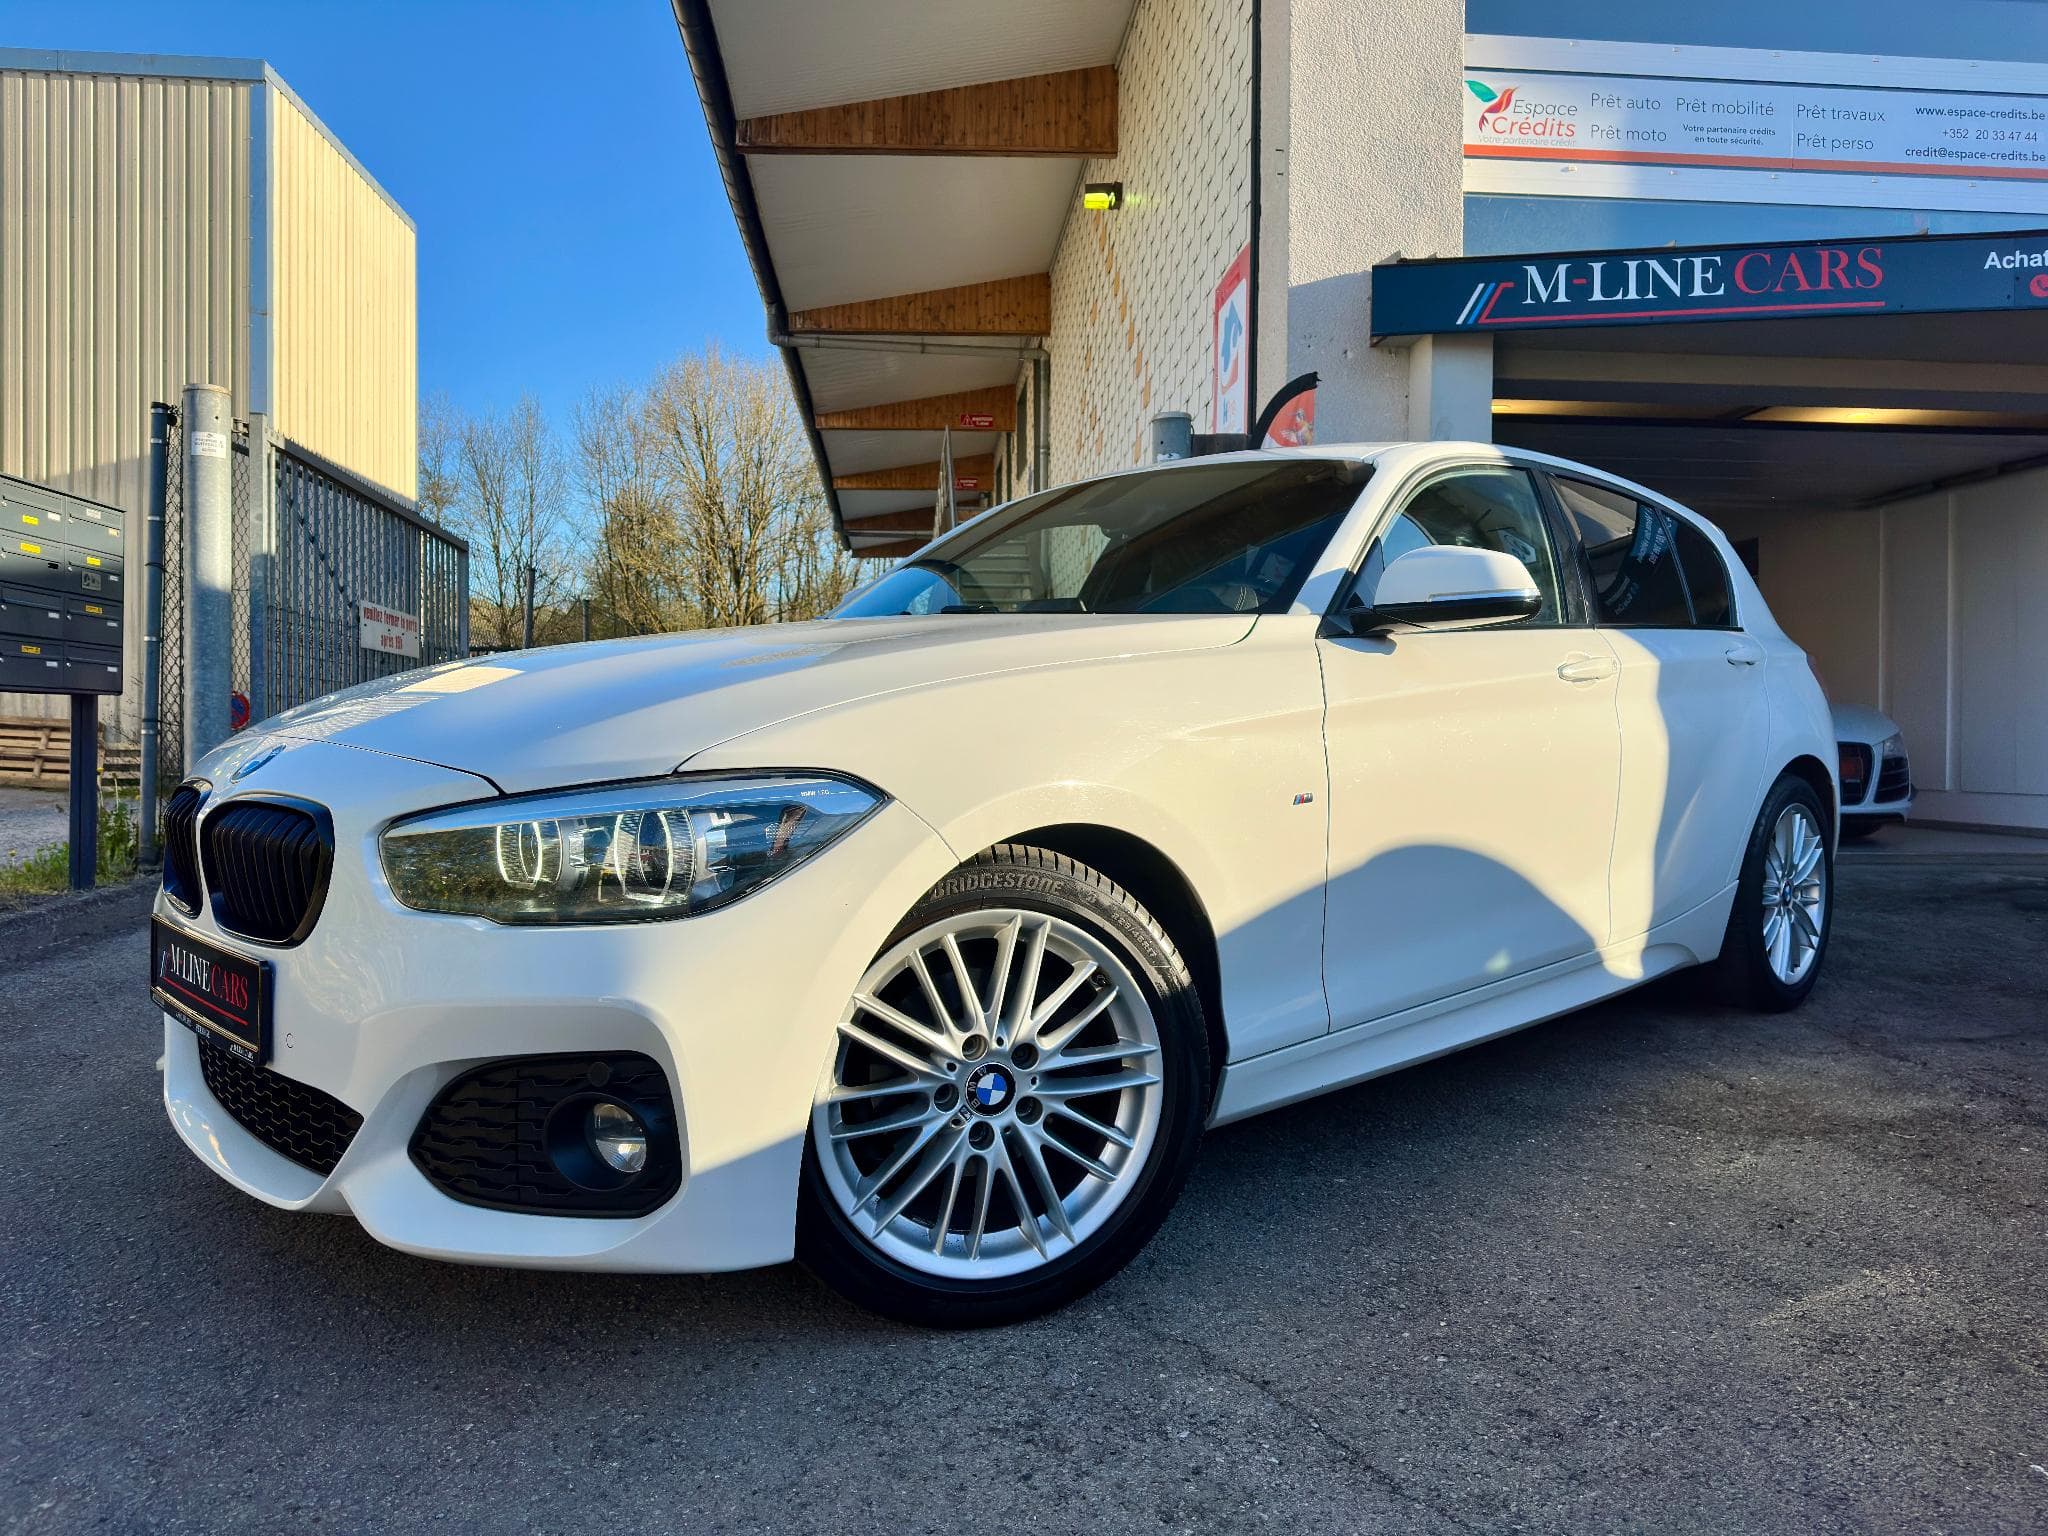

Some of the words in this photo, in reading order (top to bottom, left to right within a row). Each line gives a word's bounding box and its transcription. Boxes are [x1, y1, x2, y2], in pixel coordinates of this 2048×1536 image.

[1513, 99, 1578, 117] Espace
[1591, 92, 1621, 109] Prêt
[1626, 97, 1661, 111] auto
[1676, 97, 1706, 114] Prêt
[1711, 99, 1774, 116] mobilité
[1797, 103, 1826, 120] Prêt
[1831, 107, 1886, 123] travaux
[1915, 105, 2046, 121] www.espace-credits.be
[1493, 116, 1577, 137] Crédits
[1590, 124, 1621, 141] Prêt
[1626, 128, 1667, 142] moto
[1682, 123, 1705, 133] Votre
[1706, 125, 1748, 136] partenaire
[1749, 126, 1776, 136] crédits
[1942, 128, 1969, 140] +352
[1975, 129, 1989, 140] 20
[1992, 130, 2005, 141] 33
[2008, 131, 2021, 142] 47
[2025, 131, 2038, 142] 44
[1694, 136, 1705, 144] en
[1707, 136, 1728, 144] toute
[1797, 133, 1826, 149] Prêt
[1831, 136, 1874, 152] perso
[1905, 146, 2046, 163] credit@espace-credits.be
[1521, 255, 1725, 305] M-LINE
[1733, 247, 1885, 296] CARS
[931, 872, 1062, 902] BRIDGESTONE
[171, 943, 210, 992] M-LINE
[211, 963, 248, 1010] CARS
[967, 1066, 987, 1109] BMW
